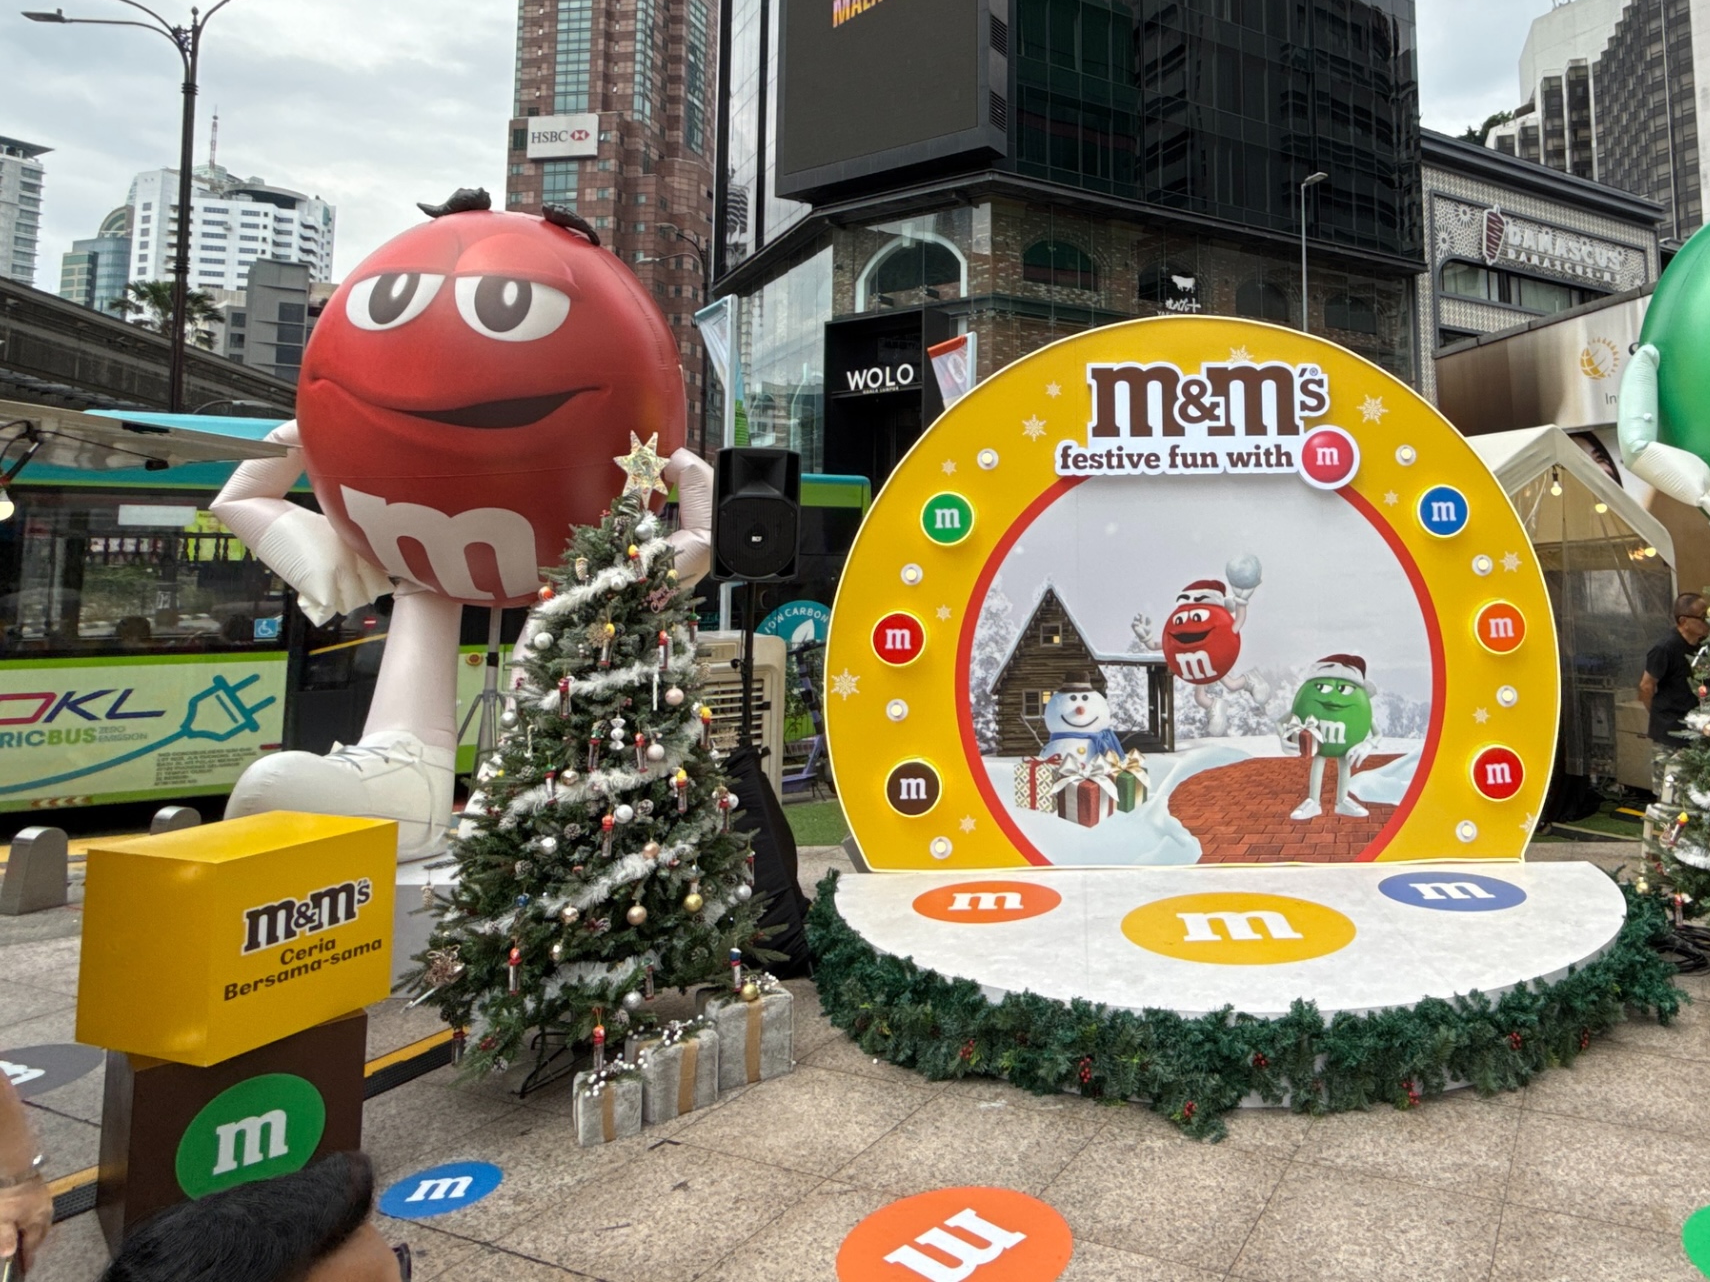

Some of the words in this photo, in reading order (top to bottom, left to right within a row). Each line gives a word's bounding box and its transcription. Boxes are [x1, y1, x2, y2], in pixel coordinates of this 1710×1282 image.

[530, 129, 569, 145] HSBC
[1506, 227, 1624, 269] DAMASCUS
[847, 363, 915, 391] WOLO
[1060, 445, 1161, 472] festive
[1168, 445, 1221, 470] fun
[1228, 444, 1293, 469] with
[1316, 445, 1339, 466] m
[936, 509, 960, 528] m
[1432, 502, 1456, 521] m
[340, 485, 538, 601] m
[886, 629, 910, 649] m
[1490, 618, 1513, 637] m
[1486, 763, 1511, 784] m
[900, 778, 926, 799] m
[1177, 911, 1302, 941] m
[279, 938, 337, 965] Ceria
[224, 937, 383, 1001] Bersama-sama
[213, 1110, 288, 1174] m
